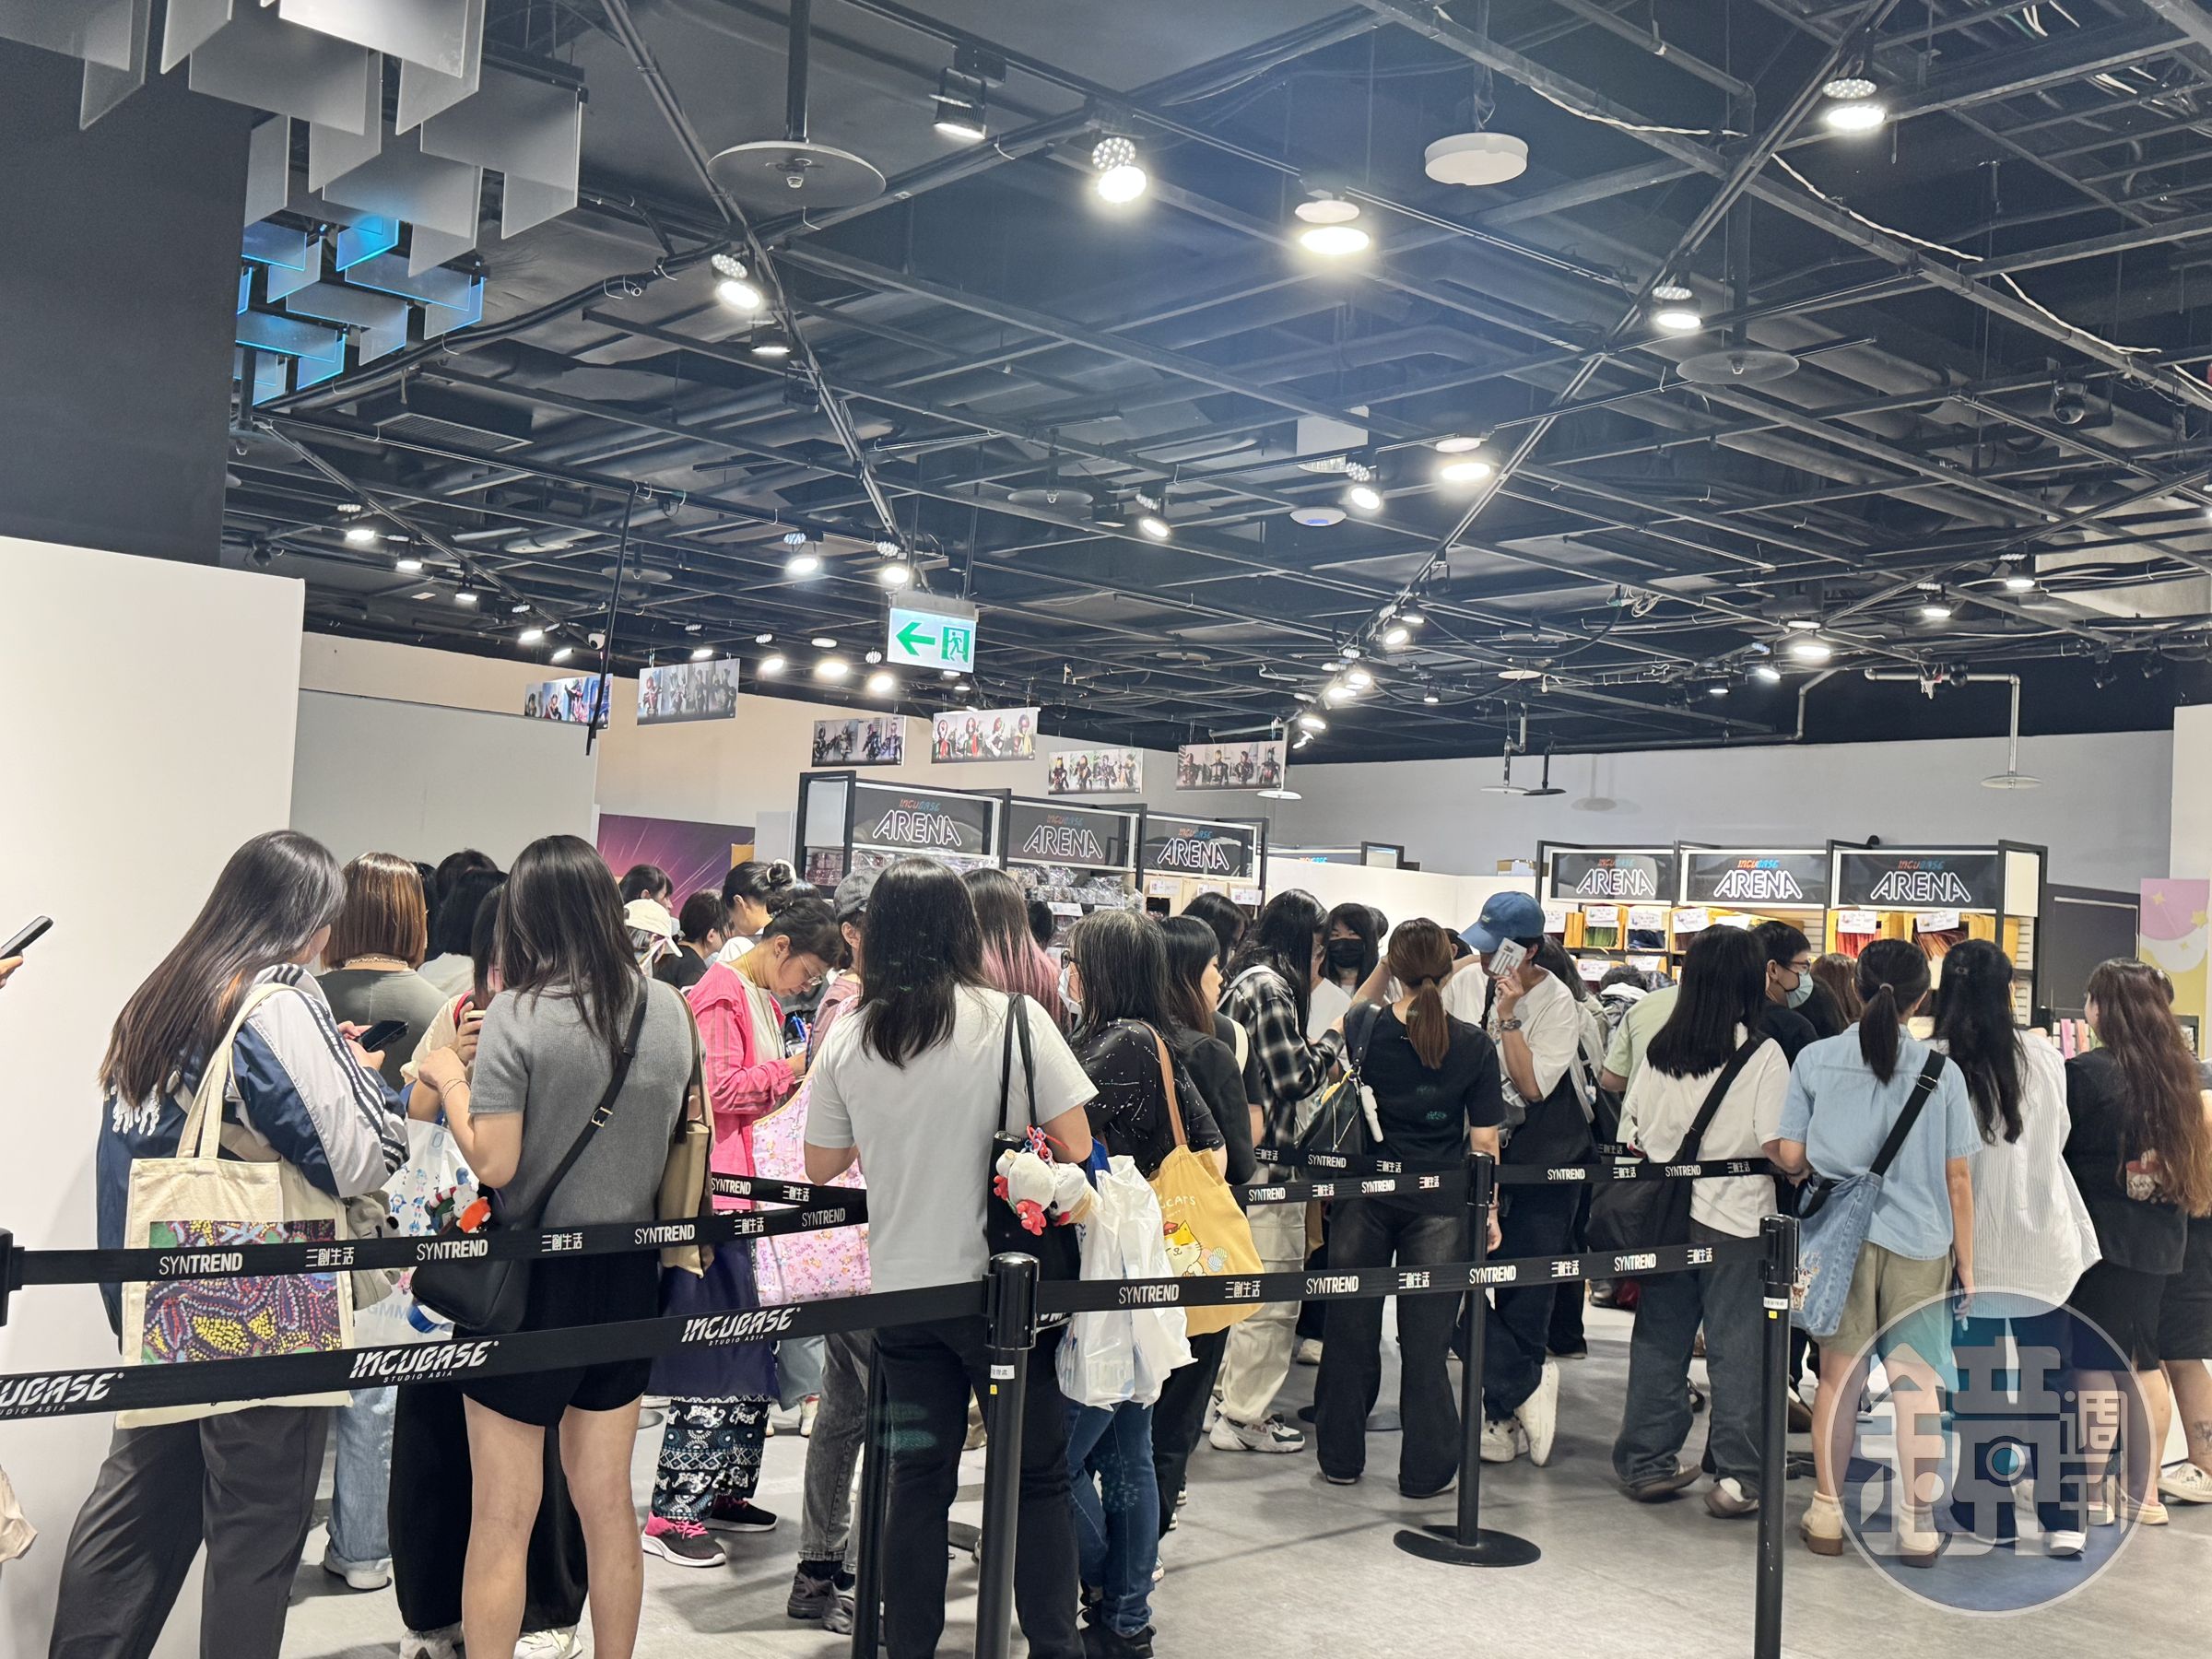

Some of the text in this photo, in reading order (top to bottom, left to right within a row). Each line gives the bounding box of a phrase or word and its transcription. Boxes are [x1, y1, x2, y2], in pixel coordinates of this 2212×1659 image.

[872, 809, 962, 846] ARENA
[1023, 824, 1103, 859] ARENA
[1157, 837, 1230, 870] ARENA
[1576, 868, 1655, 897] ARENA
[1713, 869, 1803, 900] ARENA
[1870, 871, 1971, 902] ARENA
[1308, 1155, 1347, 1169] SYNTREND
[1547, 1168, 1585, 1180] SYNTREND
[1665, 1164, 1701, 1177] SYNTREND
[711, 1178, 751, 1195] SYNTREND
[1249, 1187, 1286, 1202] SYNTREND
[1361, 1179, 1395, 1194] SYNTREND
[159, 1207, 846, 1276] SYNTREND 三創生活 SYNTREND 三創生活 SYNTREND 三創生活 SYNTREND
[1118, 1248, 1712, 1305] SYNTREND 三創生活 SYNTREND 三創生活 SYNTREND 三創生活 SYNTREND 三創生活
[708, 1334, 764, 1347] STUDIO ASIA
[383, 1370, 453, 1383] STUDIO ASIA
[35, 1405, 65, 1413] ASIA
